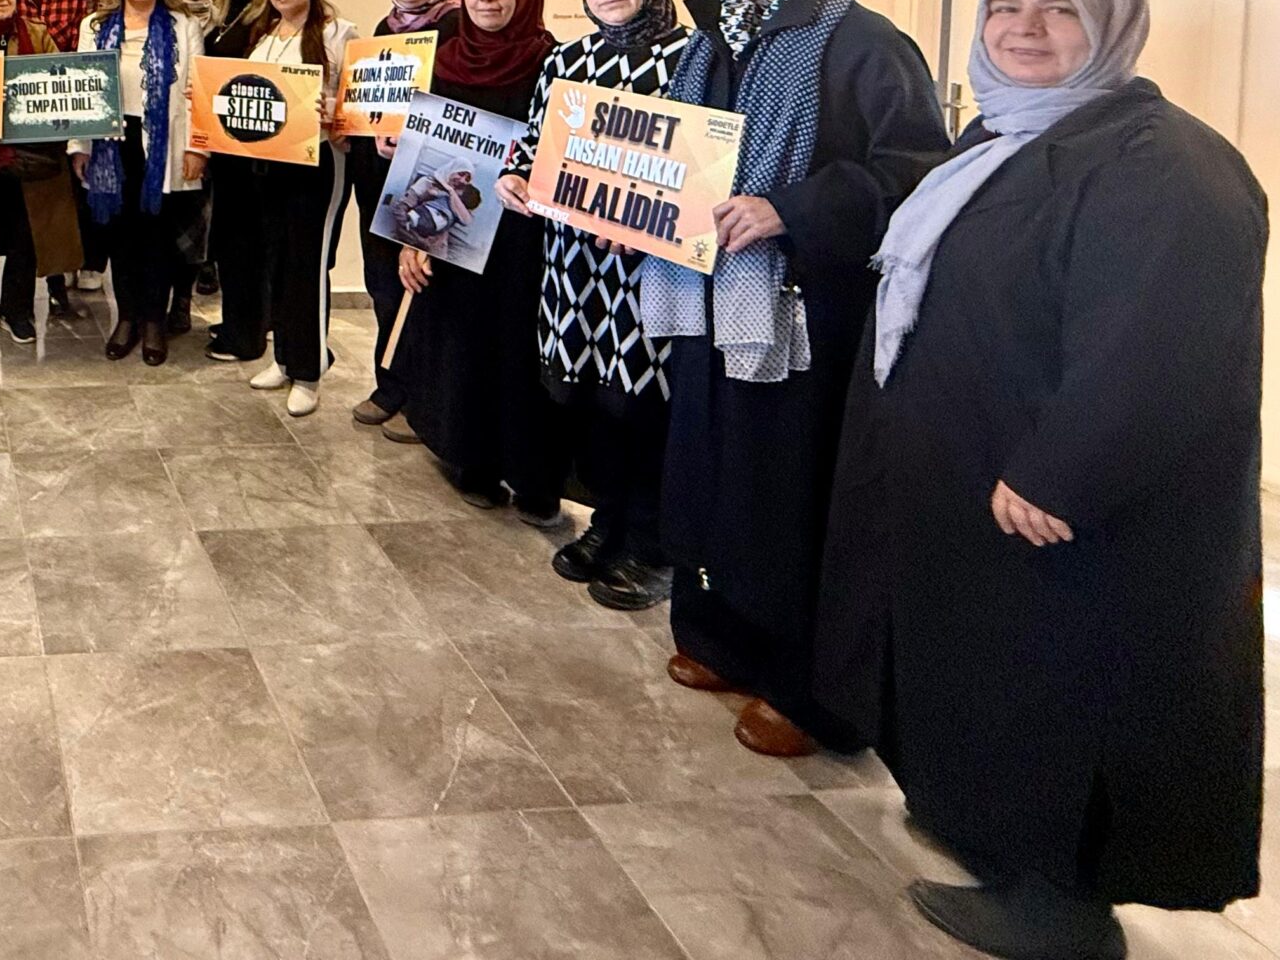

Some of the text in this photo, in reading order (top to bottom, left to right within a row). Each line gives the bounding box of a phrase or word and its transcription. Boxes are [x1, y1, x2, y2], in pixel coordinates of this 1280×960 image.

[52, 76, 72, 94] DİLİ
[74, 75, 104, 92] DEĞİL
[351, 67, 382, 83] KADINA
[26, 95, 69, 113] EMPATİ
[344, 84, 385, 103] İNSANLIĞA
[228, 97, 273, 121] SIFIR
[442, 103, 477, 127] BEN
[226, 116, 275, 133] TOLERANS
[406, 113, 431, 136] BİR
[591, 96, 681, 152] ŞİDDET
[564, 129, 688, 190] İNSAN HAKKI
[553, 163, 683, 245] İHLALİDİR.
